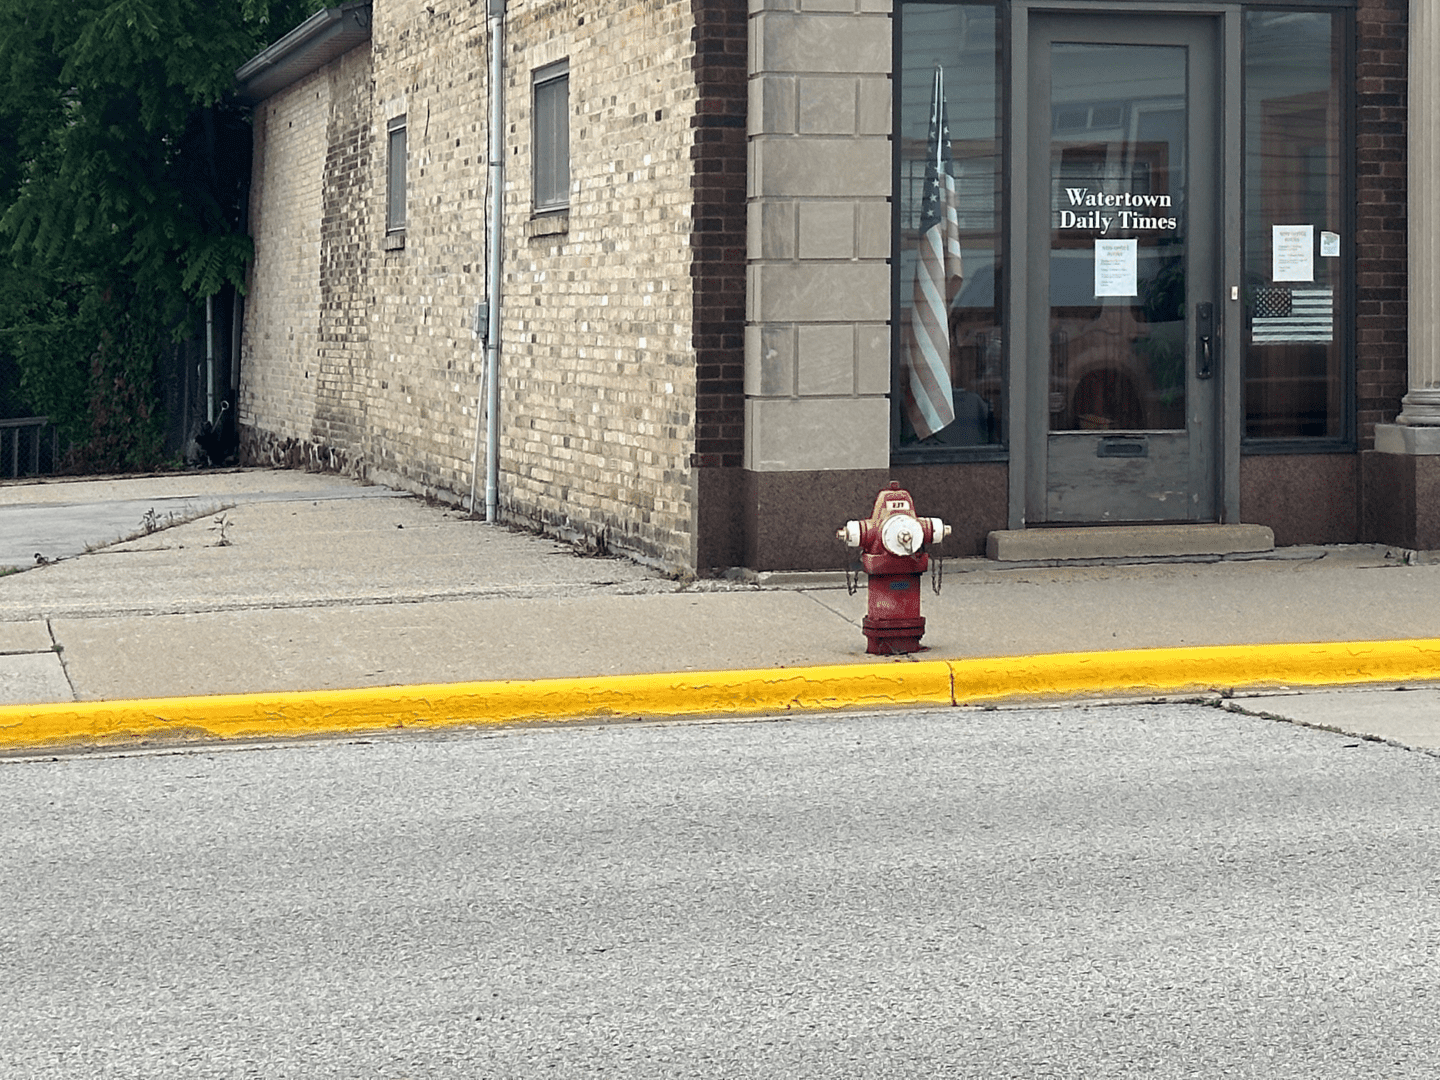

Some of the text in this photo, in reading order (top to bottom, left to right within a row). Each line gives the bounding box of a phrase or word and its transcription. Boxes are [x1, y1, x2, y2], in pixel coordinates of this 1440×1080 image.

[1065, 187, 1172, 207] Watertown
[1060, 210, 1177, 235] Daily Times
